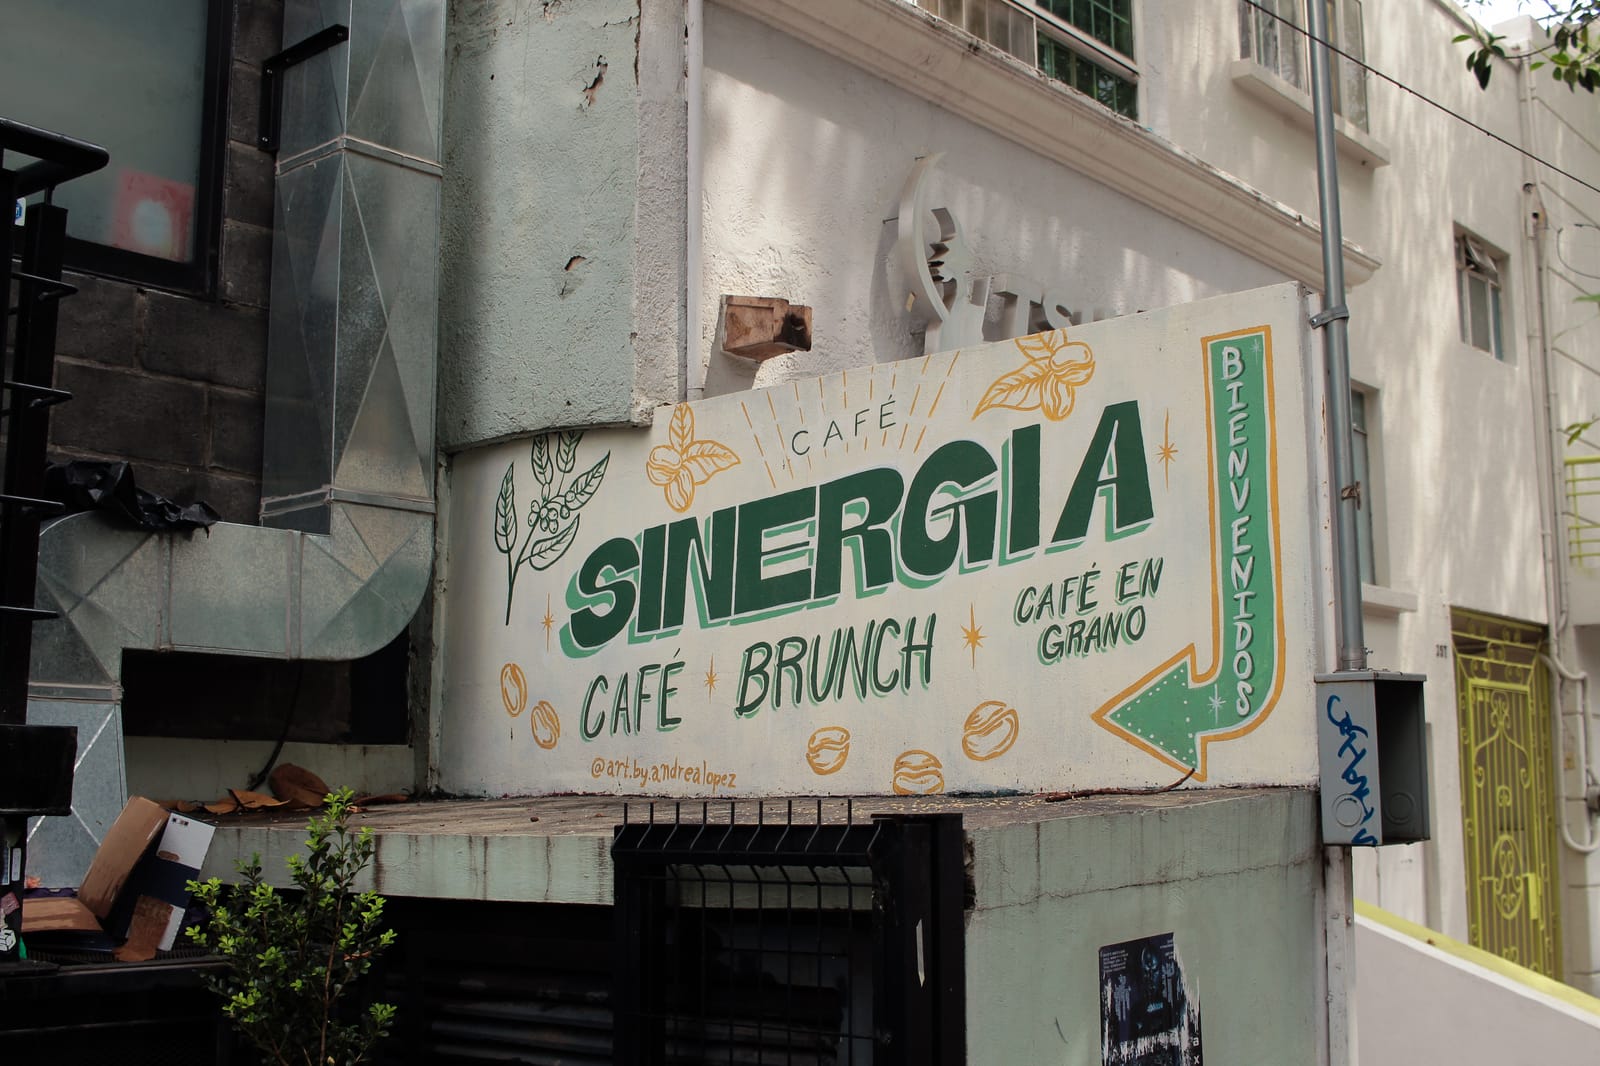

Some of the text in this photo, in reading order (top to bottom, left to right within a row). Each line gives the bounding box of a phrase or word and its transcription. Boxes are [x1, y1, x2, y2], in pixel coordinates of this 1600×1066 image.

[791, 394, 897, 456] CAFÉ
[560, 400, 1155, 658] SINERGIA
[1220, 346, 1257, 717] BIENVENIDOS
[1014, 557, 1164, 626] CAFÉ EN
[1037, 604, 1146, 666] GRANO
[580, 612, 937, 742] CAFÉ BRUNCH
[591, 754, 737, 794] @art.by.andrealopez
